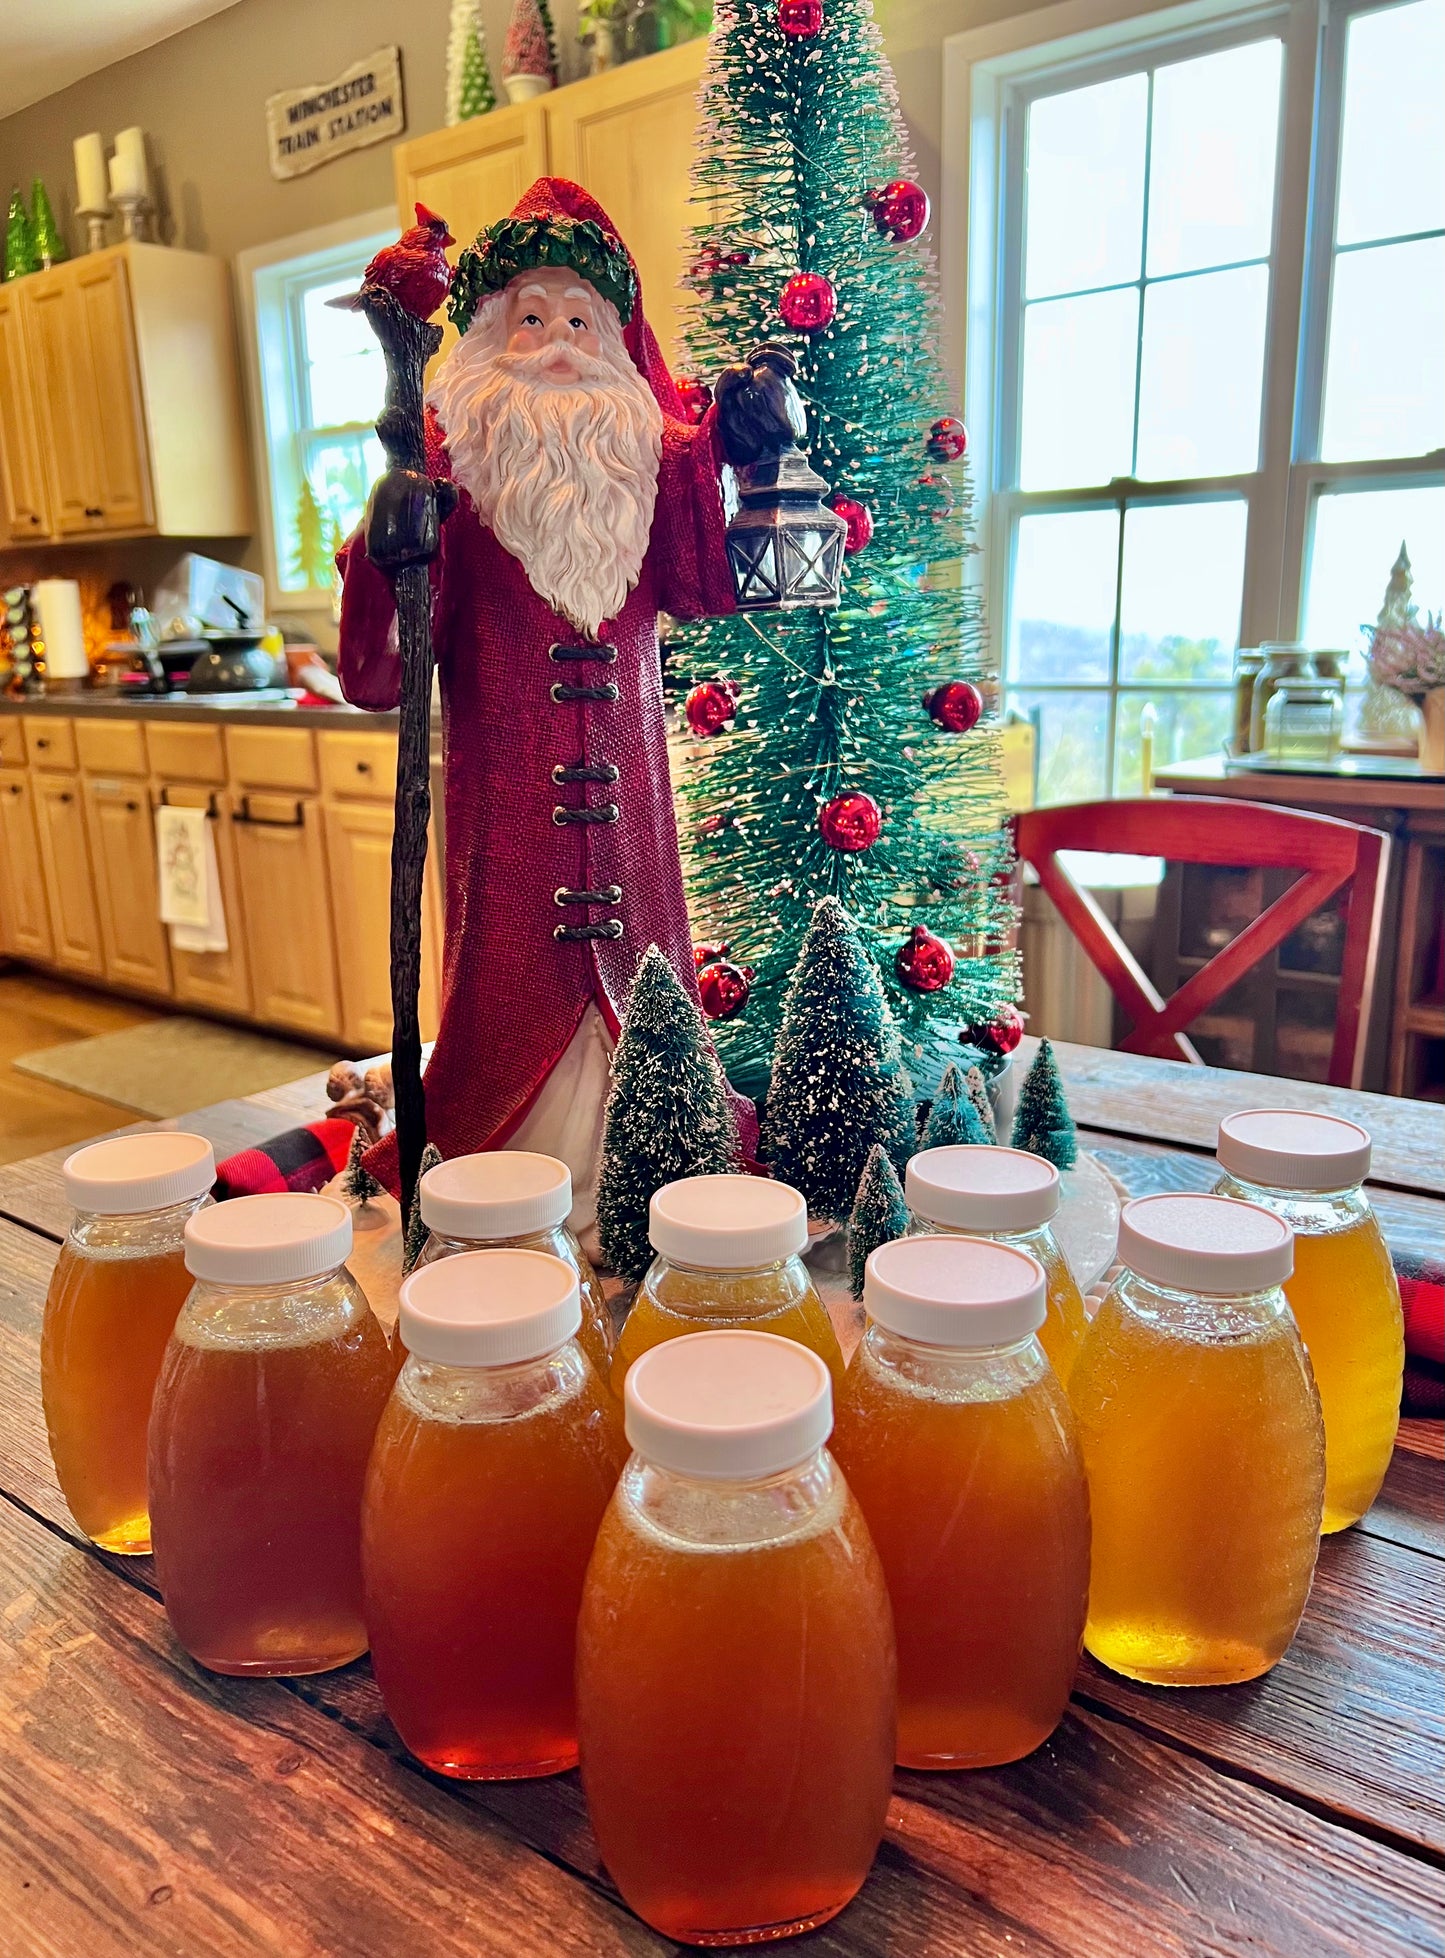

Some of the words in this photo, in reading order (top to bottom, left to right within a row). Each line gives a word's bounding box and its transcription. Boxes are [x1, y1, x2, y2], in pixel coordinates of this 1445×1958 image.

[287, 72, 375, 124] WINCHESTER
[279, 128, 319, 155] TRAIN
[329, 97, 392, 140] STATION
